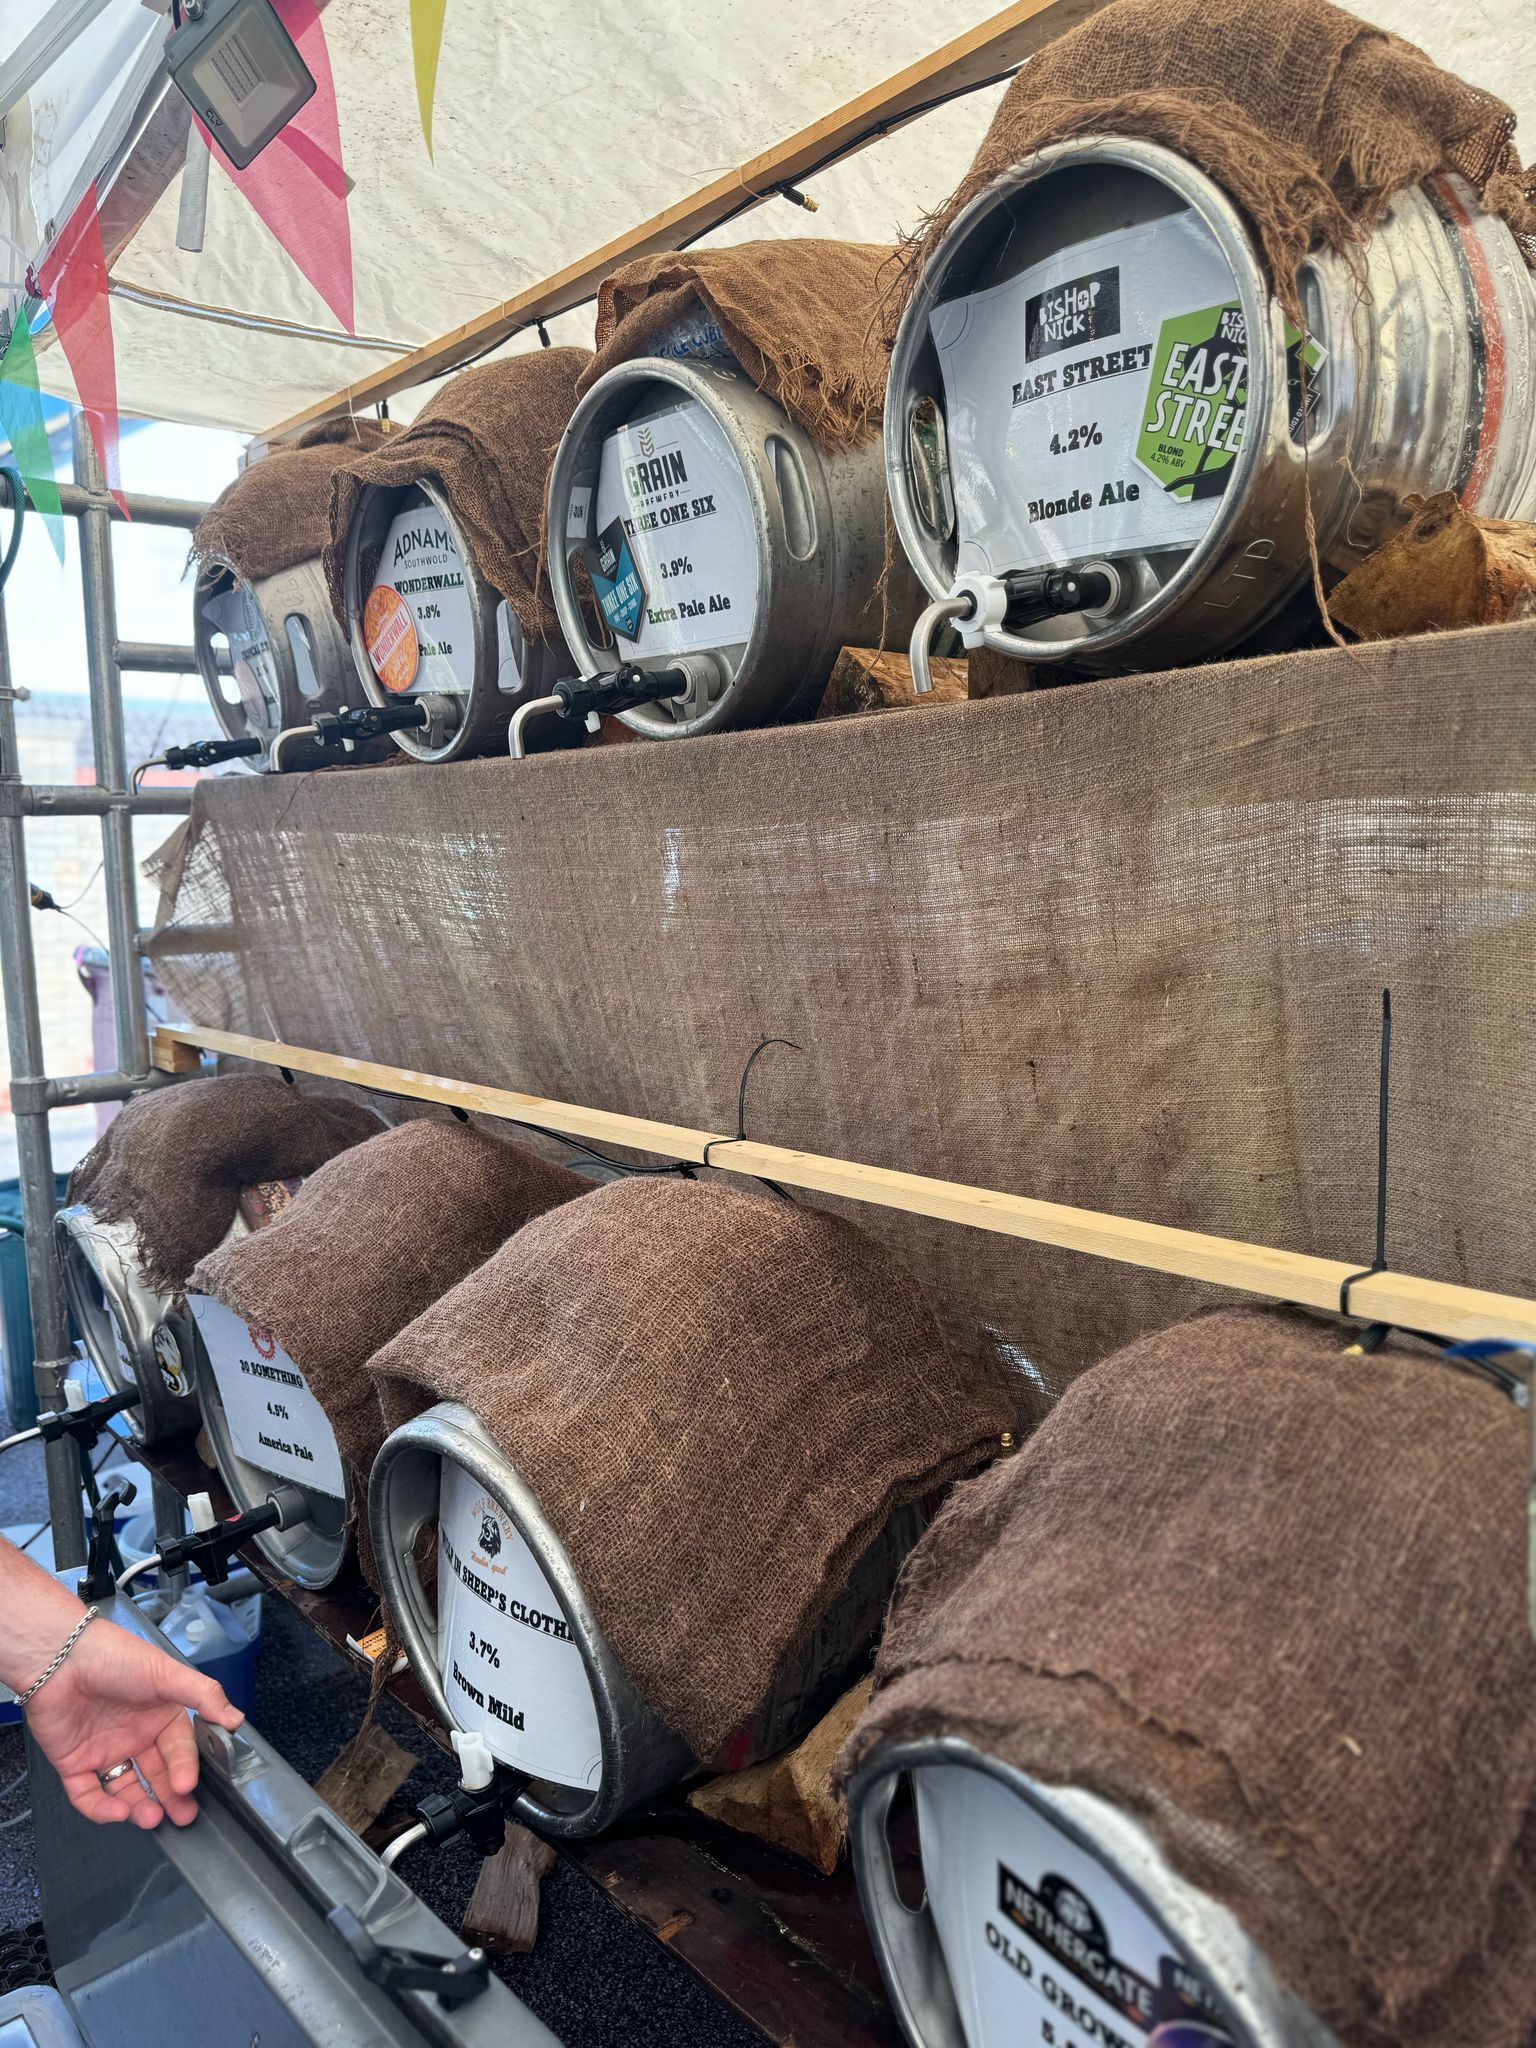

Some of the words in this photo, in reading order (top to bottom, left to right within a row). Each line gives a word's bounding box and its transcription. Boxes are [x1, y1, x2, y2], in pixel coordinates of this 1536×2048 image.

[1039, 282, 1101, 326] BISHOP
[1043, 315, 1086, 342] NICK
[1012, 370, 1057, 406] EAST
[1062, 344, 1153, 389] STREET
[1161, 341, 1249, 401] EAST
[1050, 422, 1103, 455] 4.2%
[1157, 443, 1184, 458] BLOND
[625, 450, 688, 498] GRAIN
[1150, 453, 1170, 463] 4.2%
[1170, 457, 1186, 468] ABV
[660, 500, 690, 527] ONE
[692, 494, 716, 515] SIX
[1028, 489, 1093, 524] Blonde
[1099, 480, 1140, 507] Ale
[404, 553, 448, 569] SOUTHWOLD
[660, 556, 693, 579] 3.9%
[394, 572, 464, 595] WONDERWALL
[615, 580, 629, 604] ONE
[625, 571, 638, 595] SIX
[417, 604, 441, 620] 3.8%
[647, 607, 678, 624] Extra
[678, 599, 706, 619] Pale
[708, 594, 731, 612] Ale
[419, 643, 437, 657] Pale
[437, 641, 453, 655] Ale
[239, 1359, 251, 1373] 30
[251, 1362, 304, 1388] SOMETHING
[267, 1401, 289, 1420] 4.5%
[258, 1432, 292, 1454] America
[292, 1442, 314, 1462] Pale
[462, 1565, 508, 1612] SHEEP'S
[469, 1630, 500, 1669] 3.7%
[453, 1660, 484, 1708] Brown
[487, 1694, 526, 1731] Mild
[985, 1921, 1033, 1979] OLD
[1005, 1878, 1155, 2018] NETHERGATE
